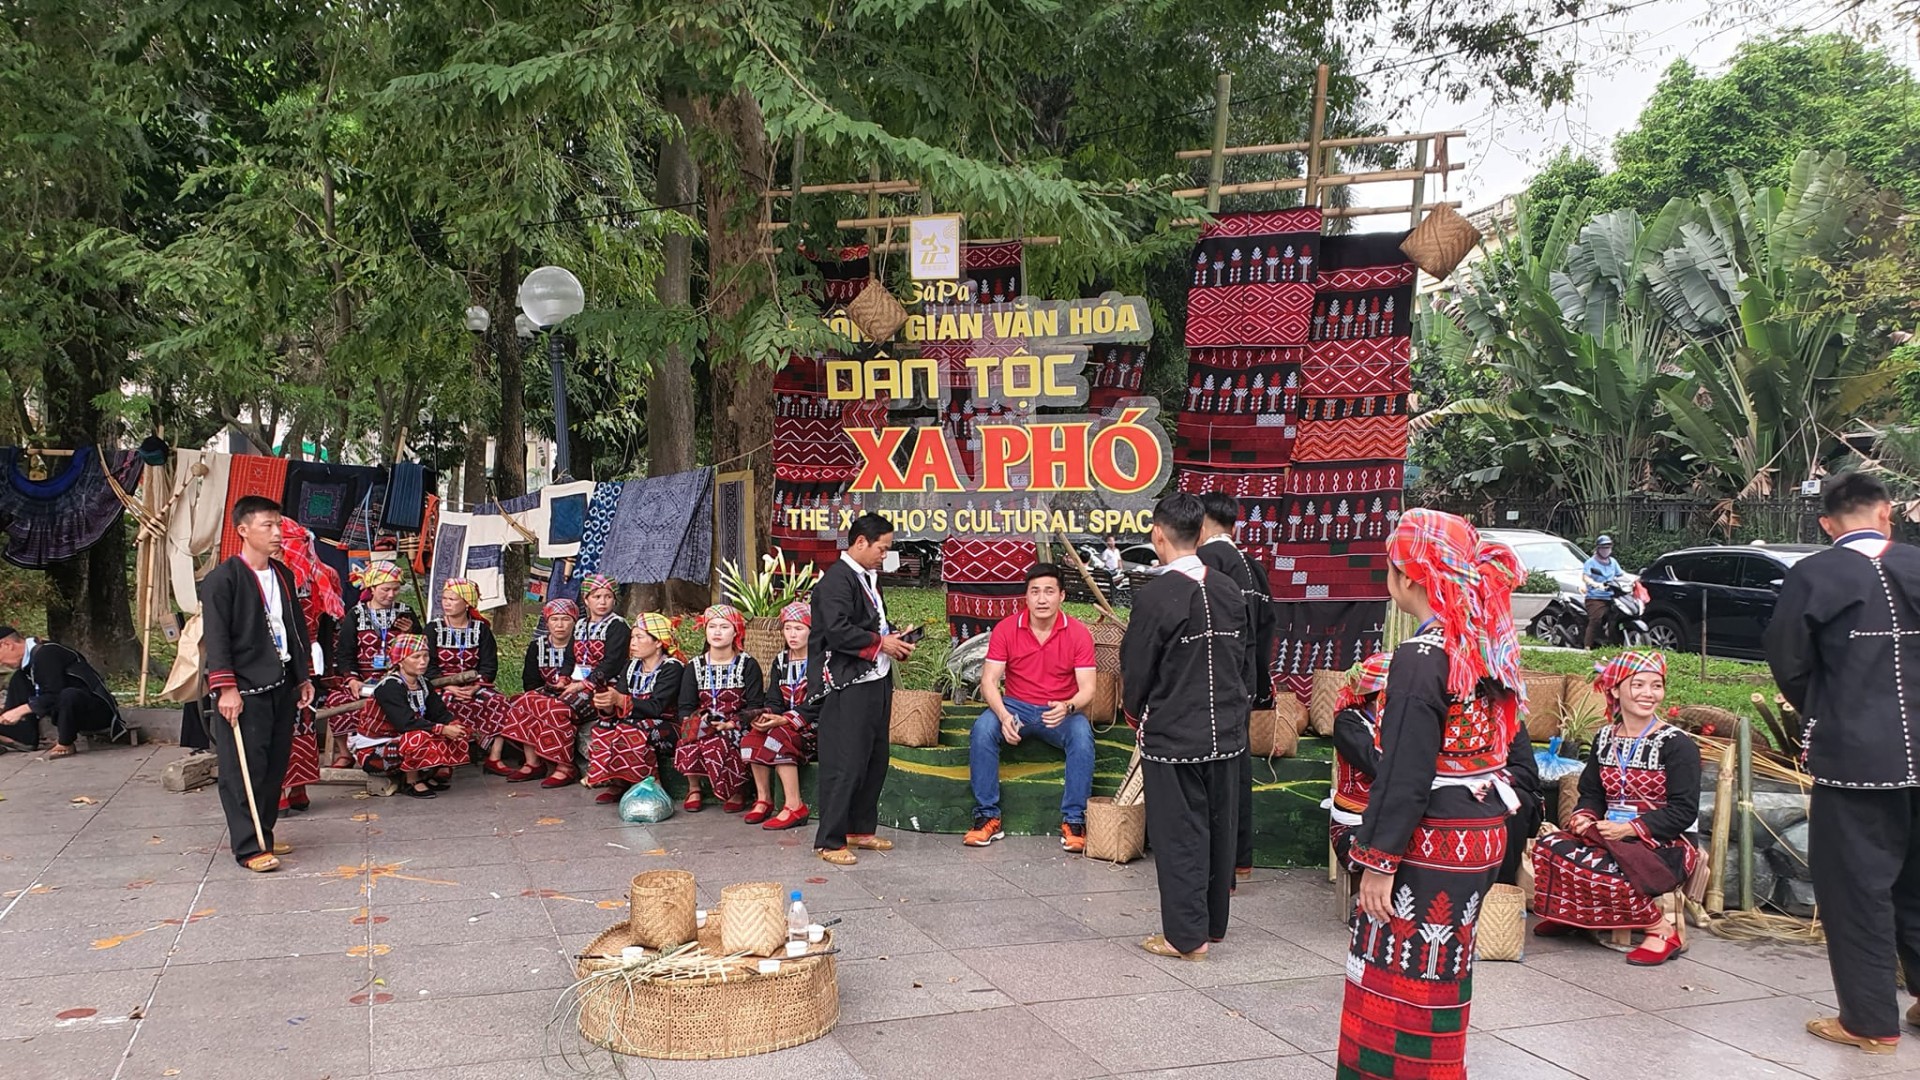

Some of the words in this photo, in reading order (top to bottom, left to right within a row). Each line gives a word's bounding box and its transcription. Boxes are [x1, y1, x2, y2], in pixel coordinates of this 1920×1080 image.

[905, 313, 983, 341] GIAN
[992, 303, 1058, 338] VĂN
[1069, 299, 1141, 334] HÓA
[965, 347, 1077, 409] TỘC
[842, 426, 966, 493] XA
[976, 407, 1163, 494] PHÓ
[786, 509, 830, 531] THE
[838, 509, 868, 532] X
[954, 509, 1084, 533] CULTURAL
[1088, 509, 1154, 534] SPAC
